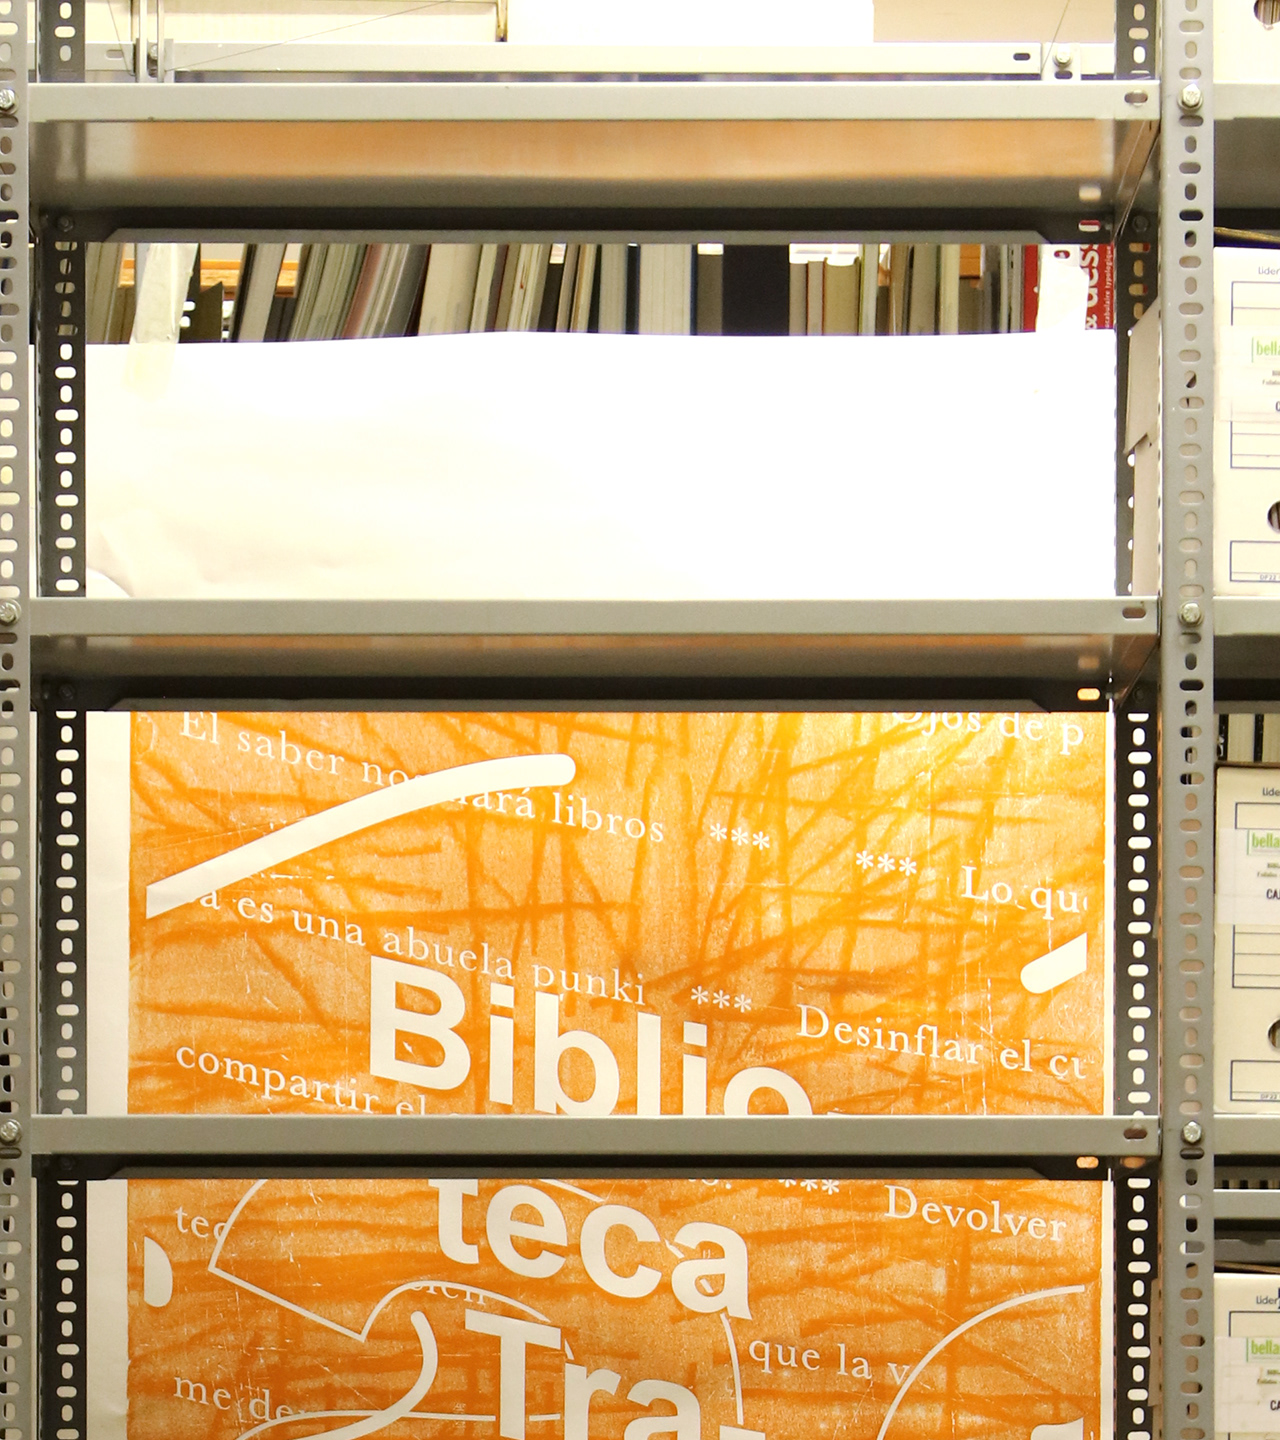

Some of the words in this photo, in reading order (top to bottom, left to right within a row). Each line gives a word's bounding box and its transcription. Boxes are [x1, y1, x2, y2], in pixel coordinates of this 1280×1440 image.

[999, 712, 1043, 741] de
[180, 712, 219, 744] El
[237, 731, 345, 773] saber
[552, 794, 665, 843] libros
[962, 866, 1013, 903] Lo
[238, 896, 274, 922] es
[292, 908, 365, 947] una
[383, 927, 514, 980] abuela
[532, 962, 645, 1005] punki
[370, 956, 814, 1115] Biblio
[797, 1004, 984, 1066] Desinflar
[1000, 1039, 1032, 1071] el
[176, 1043, 378, 1115] compartir
[884, 1185, 1067, 1242] Devolver
[428, 1178, 752, 1319] teca
[174, 1375, 232, 1410] me
[749, 1339, 820, 1375] que
[837, 1344, 872, 1379] la
